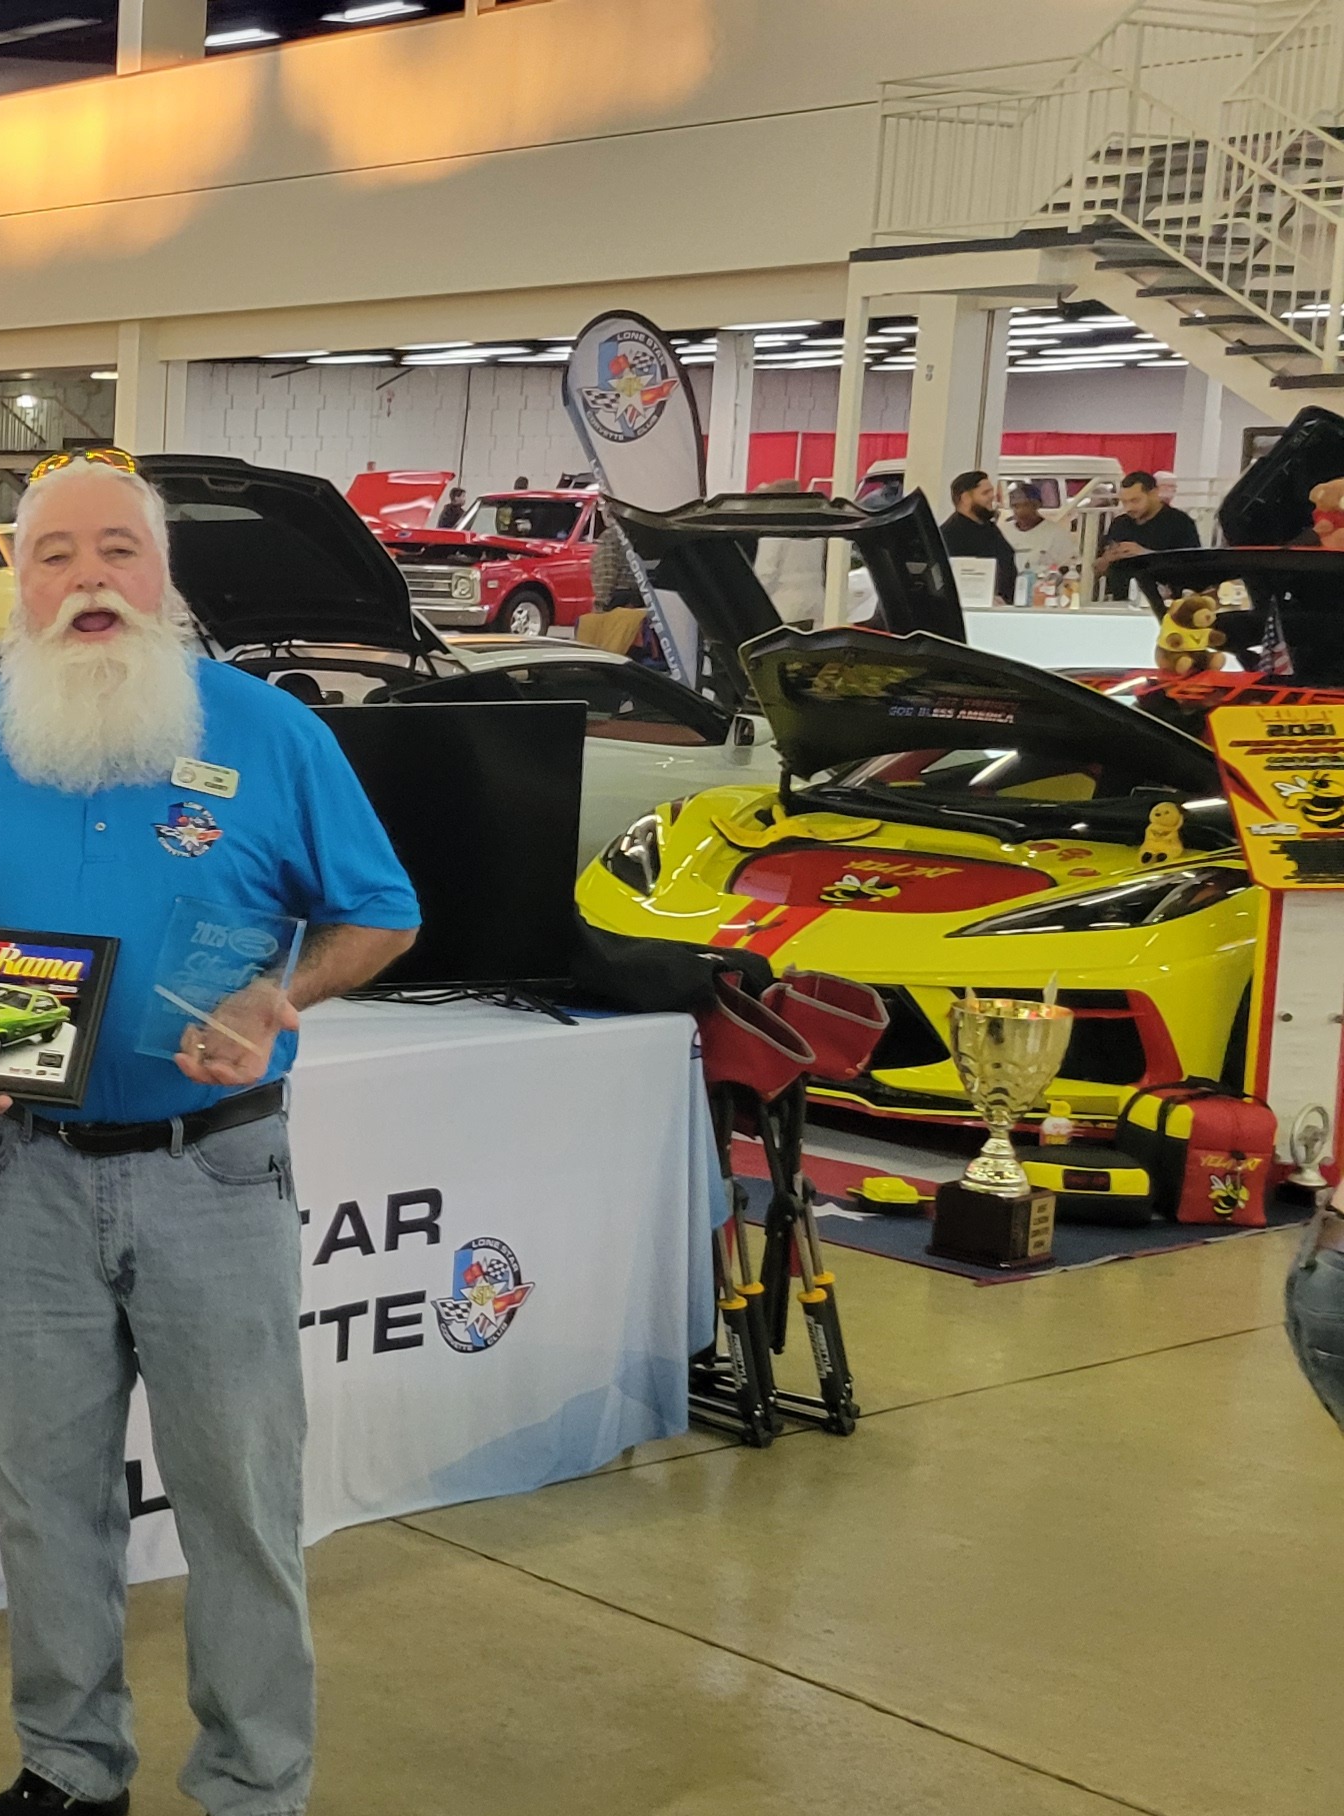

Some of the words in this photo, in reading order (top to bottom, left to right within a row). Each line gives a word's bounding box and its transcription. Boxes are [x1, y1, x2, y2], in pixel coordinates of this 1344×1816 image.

[617, 332, 646, 343] LONE
[888, 706, 914, 716] GOD
[917, 707, 956, 719] BLESS
[956, 709, 1015, 724] AMERICA
[1266, 723, 1337, 737] 2021
[299, 1188, 442, 1266] AR
[472, 1239, 501, 1248] LONE
[501, 1245, 519, 1272] STAR
[487, 1322, 508, 1345] CLUB
